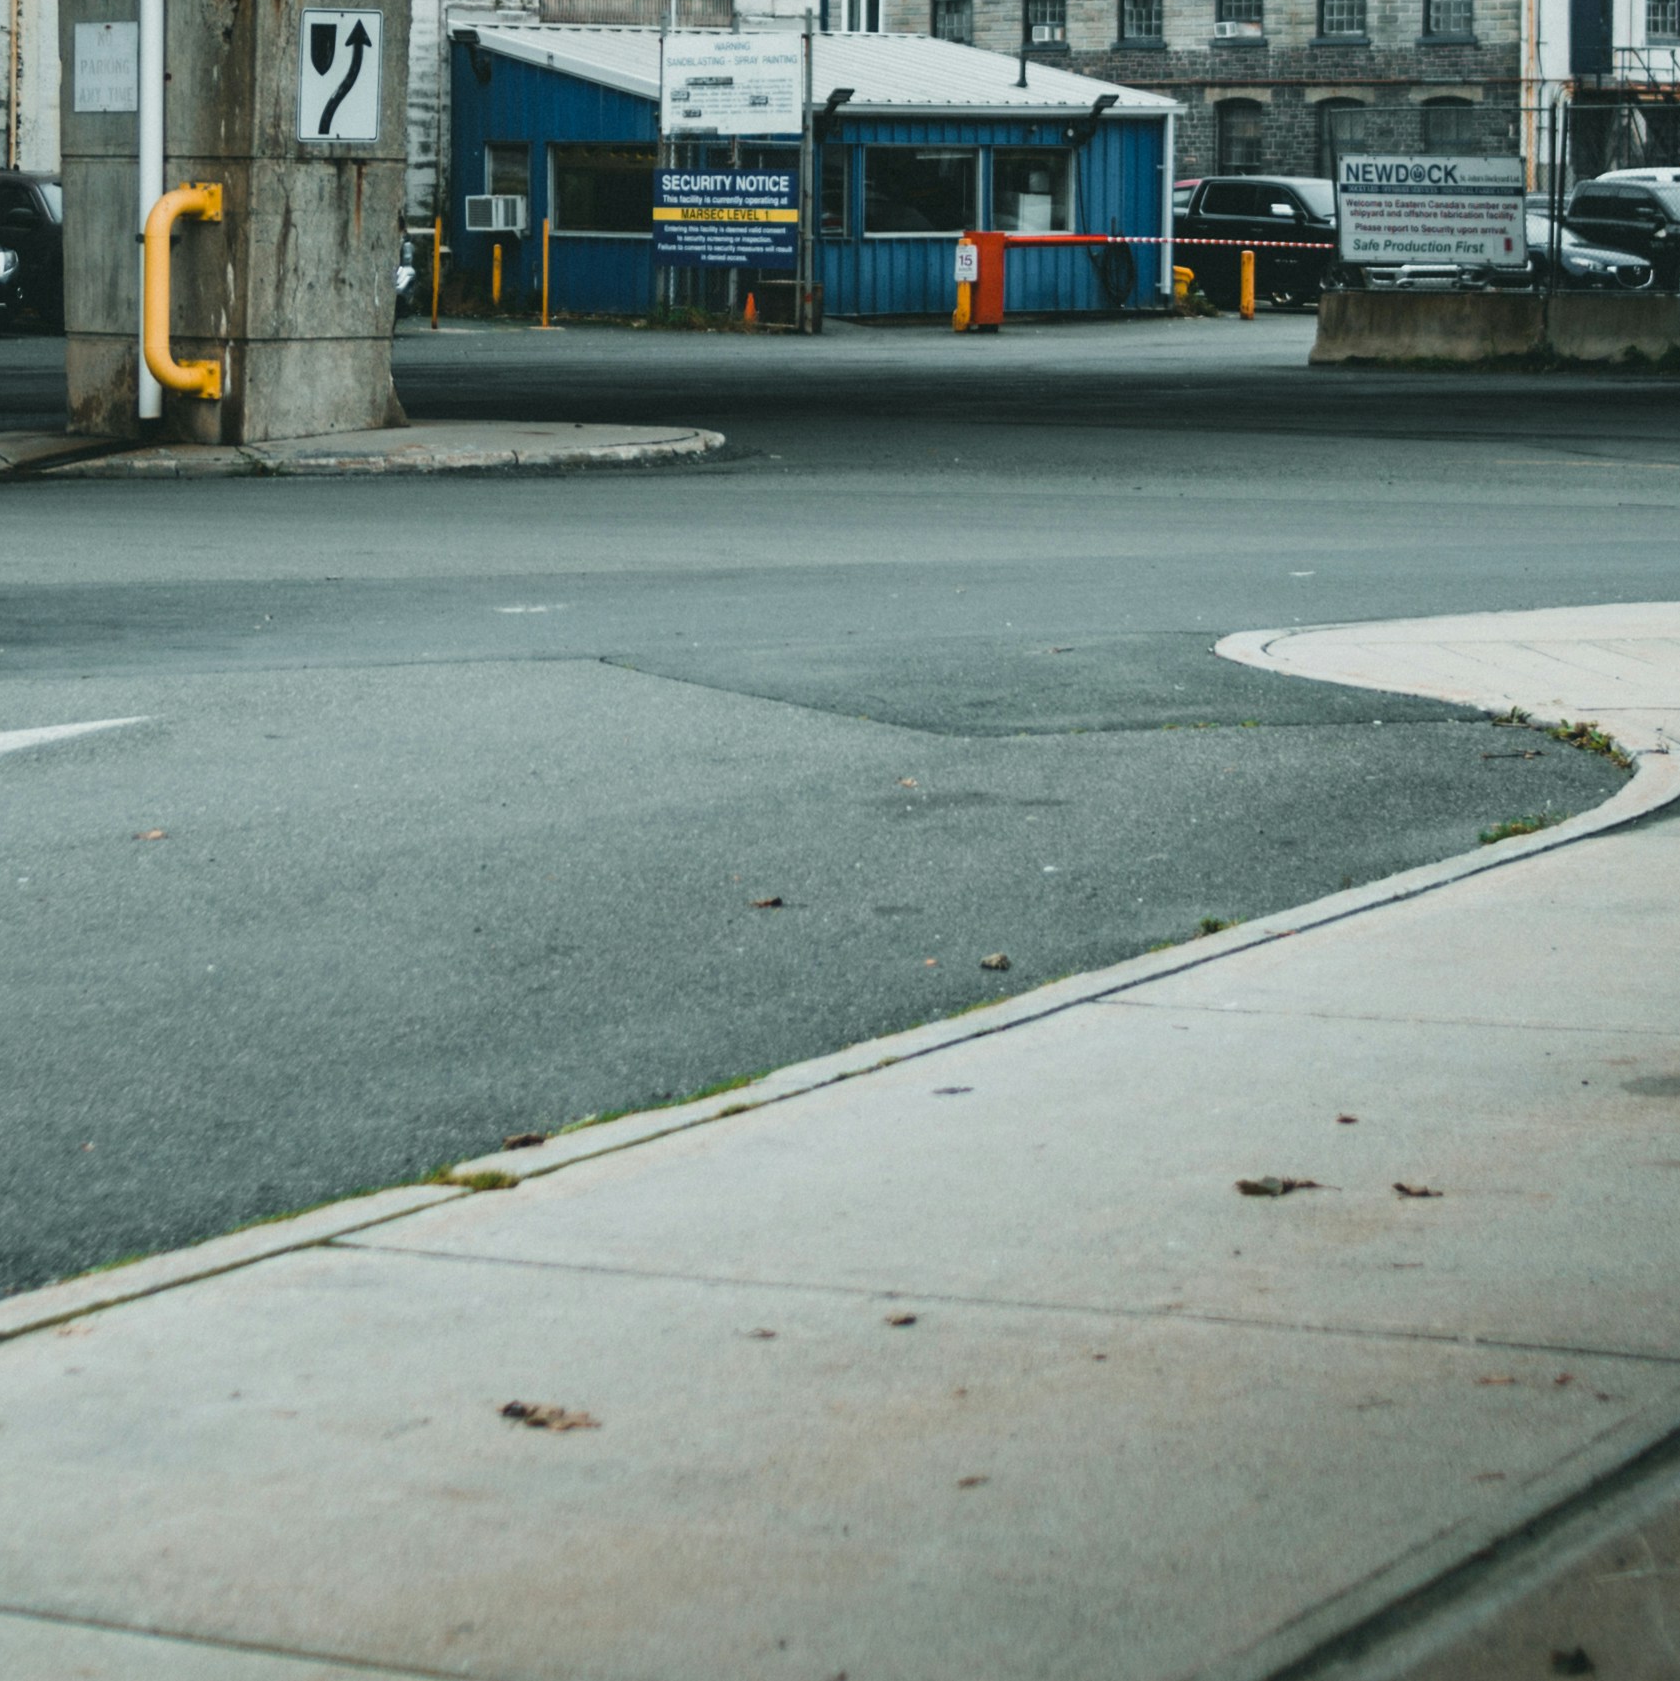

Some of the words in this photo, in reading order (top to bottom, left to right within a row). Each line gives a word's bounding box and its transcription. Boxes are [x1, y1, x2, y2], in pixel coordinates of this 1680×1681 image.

[97, 31, 112, 47] NO
[714, 41, 751, 51] WARNING
[80, 59, 130, 75] PARKING
[666, 56, 725, 67] SANDBLASTING
[734, 56, 759, 65] SPRAY
[763, 54, 798, 65] PAINTING
[108, 87, 134, 103] TIME
[662, 175, 731, 191] SECURITY
[736, 176, 789, 192] NOTICE
[663, 194, 678, 204] This
[679, 195, 703, 206] facility
[704, 196, 711, 204] is
[712, 196, 742, 206] currently
[745, 196, 779, 207] operating
[780, 197, 788, 205] at
[1346, 199, 1382, 208] Welcome
[1384, 199, 1393, 208] to
[1395, 199, 1426, 208] Eastern
[1428, 200, 1466, 210] Canada's
[1468, 201, 1499, 210] number
[681, 208, 724, 220] MARSEC
[727, 209, 759, 221] LEVEL
[765, 210, 770, 221] 1
[1350, 209, 1384, 218] shipyard
[1386, 209, 1402, 217] and
[1404, 210, 1438, 218] offshore
[1440, 210, 1484, 219] fabrication
[664, 224, 687, 233] Entering
[700, 225, 718, 234] facility
[1354, 223, 1382, 232] Please
[1384, 224, 1409, 233] report
[1410, 224, 1419, 232] to
[1421, 224, 1455, 235] Security
[1457, 227, 1478, 235] upon
[684, 235, 705, 243] security
[1353, 238, 1380, 251] Safe
[1383, 239, 1452, 253] Production
[1455, 241, 1485, 253] First
[658, 243, 677, 251] Failure
[714, 245, 735, 253] security
[959, 254, 973, 267] 15
